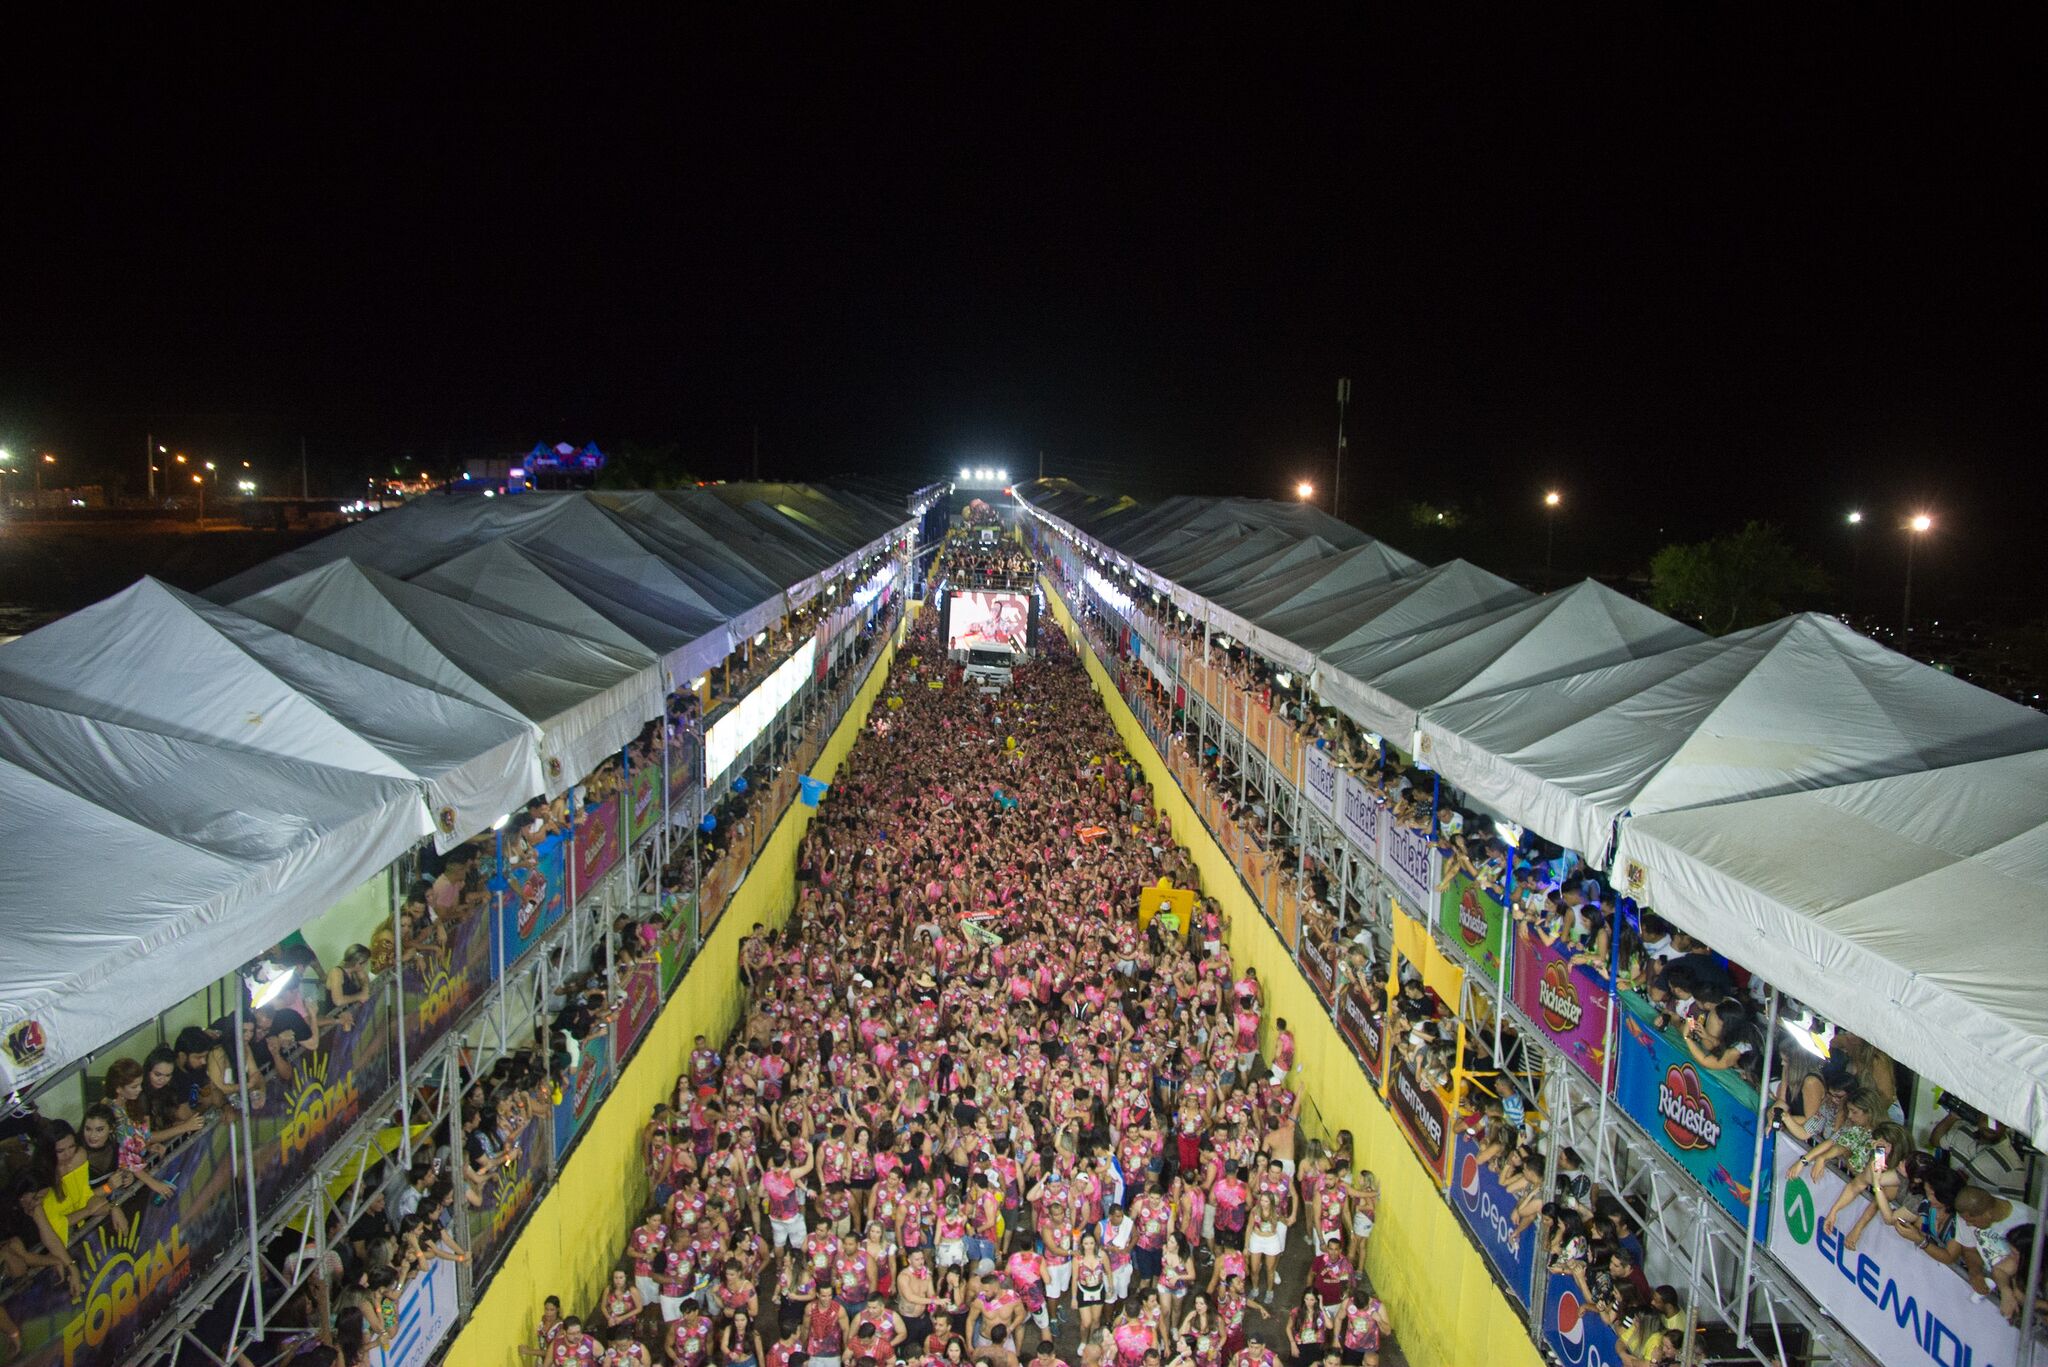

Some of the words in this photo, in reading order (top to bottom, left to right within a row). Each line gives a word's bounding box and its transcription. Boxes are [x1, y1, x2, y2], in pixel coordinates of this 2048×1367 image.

[1458, 904, 1488, 938] Richester
[1539, 979, 1583, 1026] Richester
[280, 1069, 360, 1167] FORTAL
[1658, 1083, 1721, 1147] Richester
[63, 1223, 191, 1367] FORTAL
